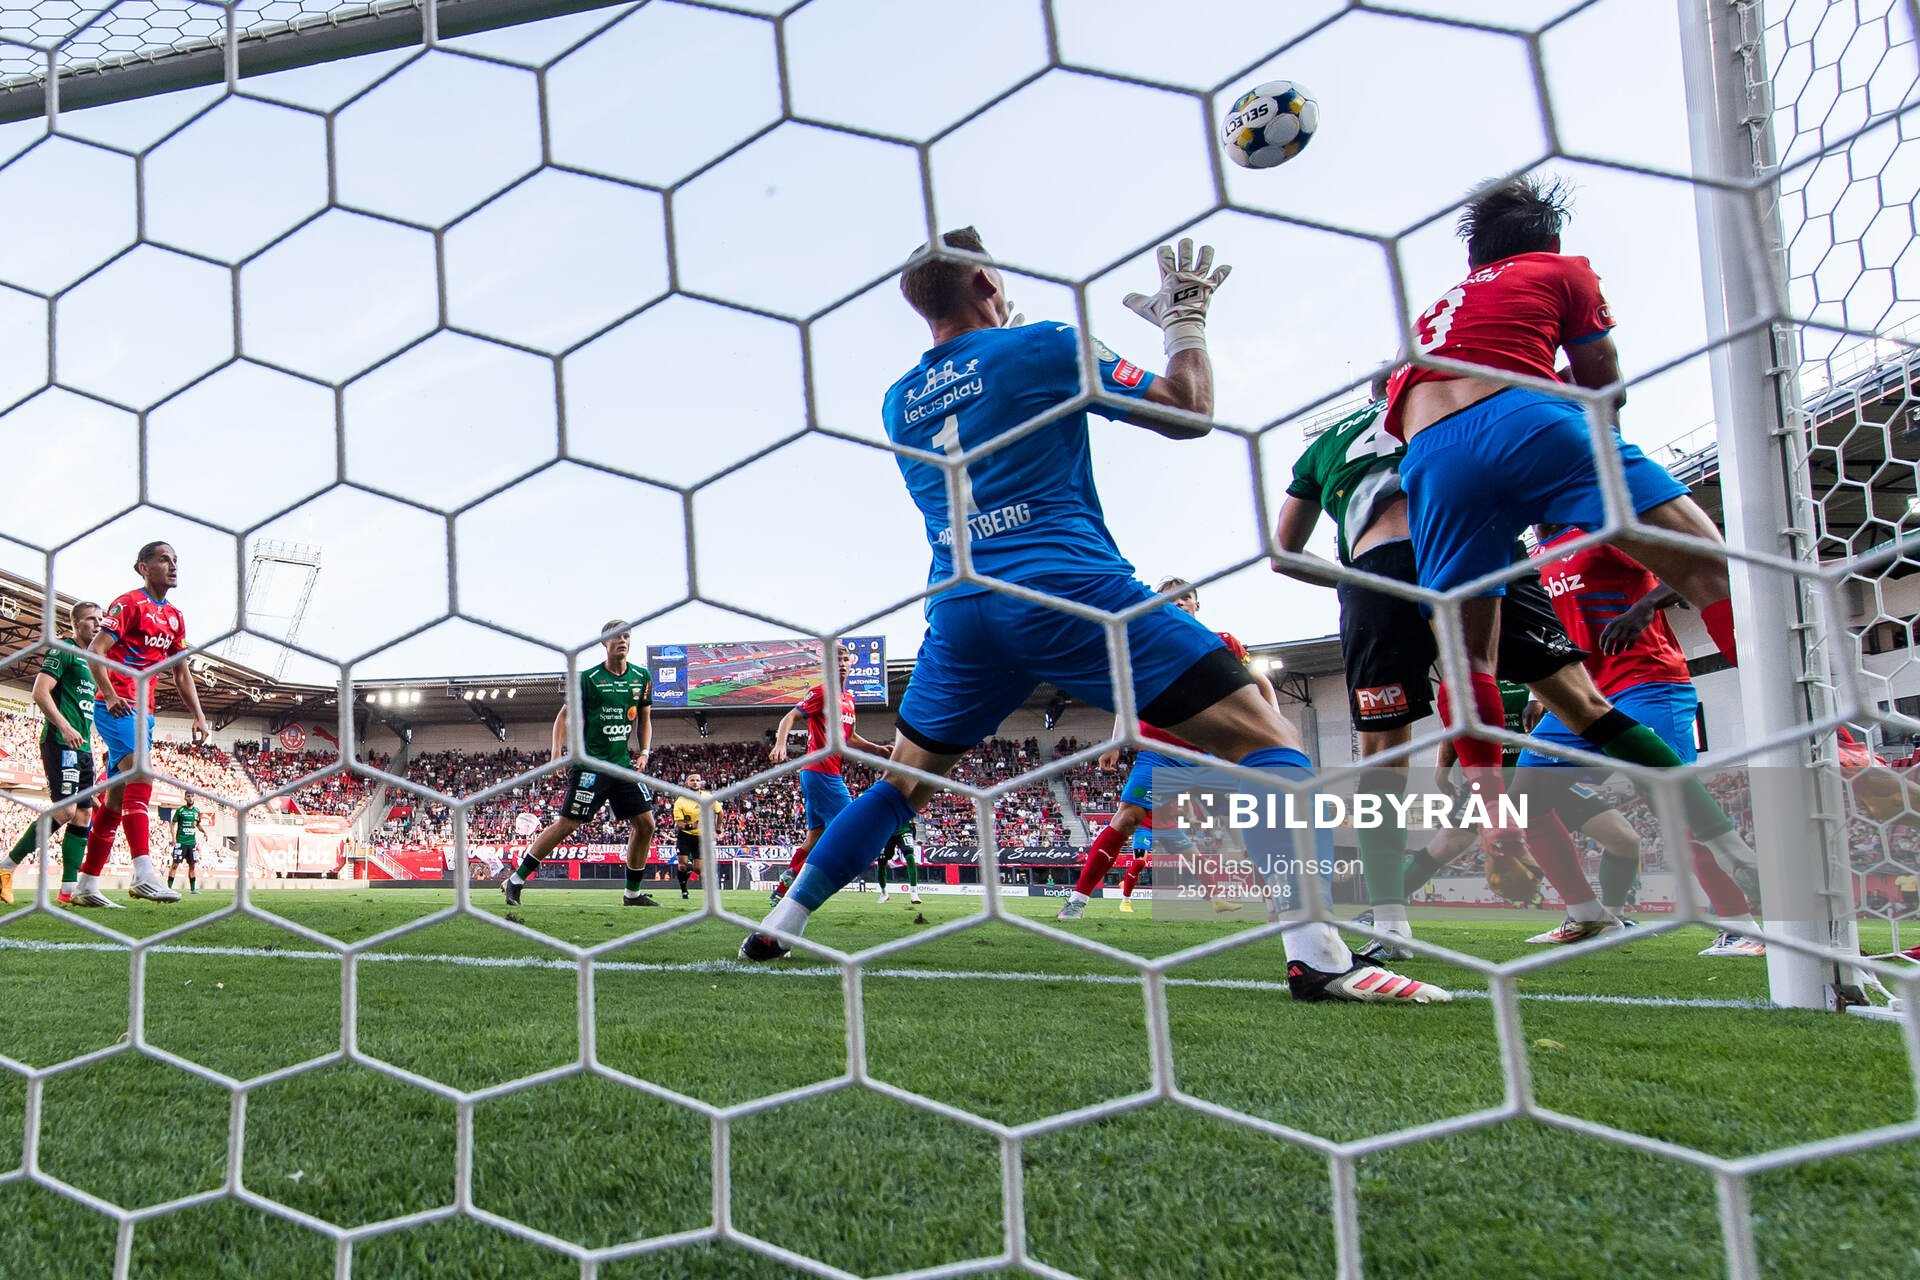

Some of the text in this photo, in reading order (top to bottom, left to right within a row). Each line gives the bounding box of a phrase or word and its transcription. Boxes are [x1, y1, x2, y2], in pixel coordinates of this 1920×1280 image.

[1225, 103, 1269, 137] SELECT
[1414, 288, 1466, 356] 3
[904, 377, 983, 424] letusplay
[930, 413, 981, 516] 1
[848, 641, 856, 651] 0
[870, 641, 879, 650] 0
[848, 667, 880, 676] 22:03
[1358, 685, 1402, 709] FMP
[602, 724, 632, 736] coop
